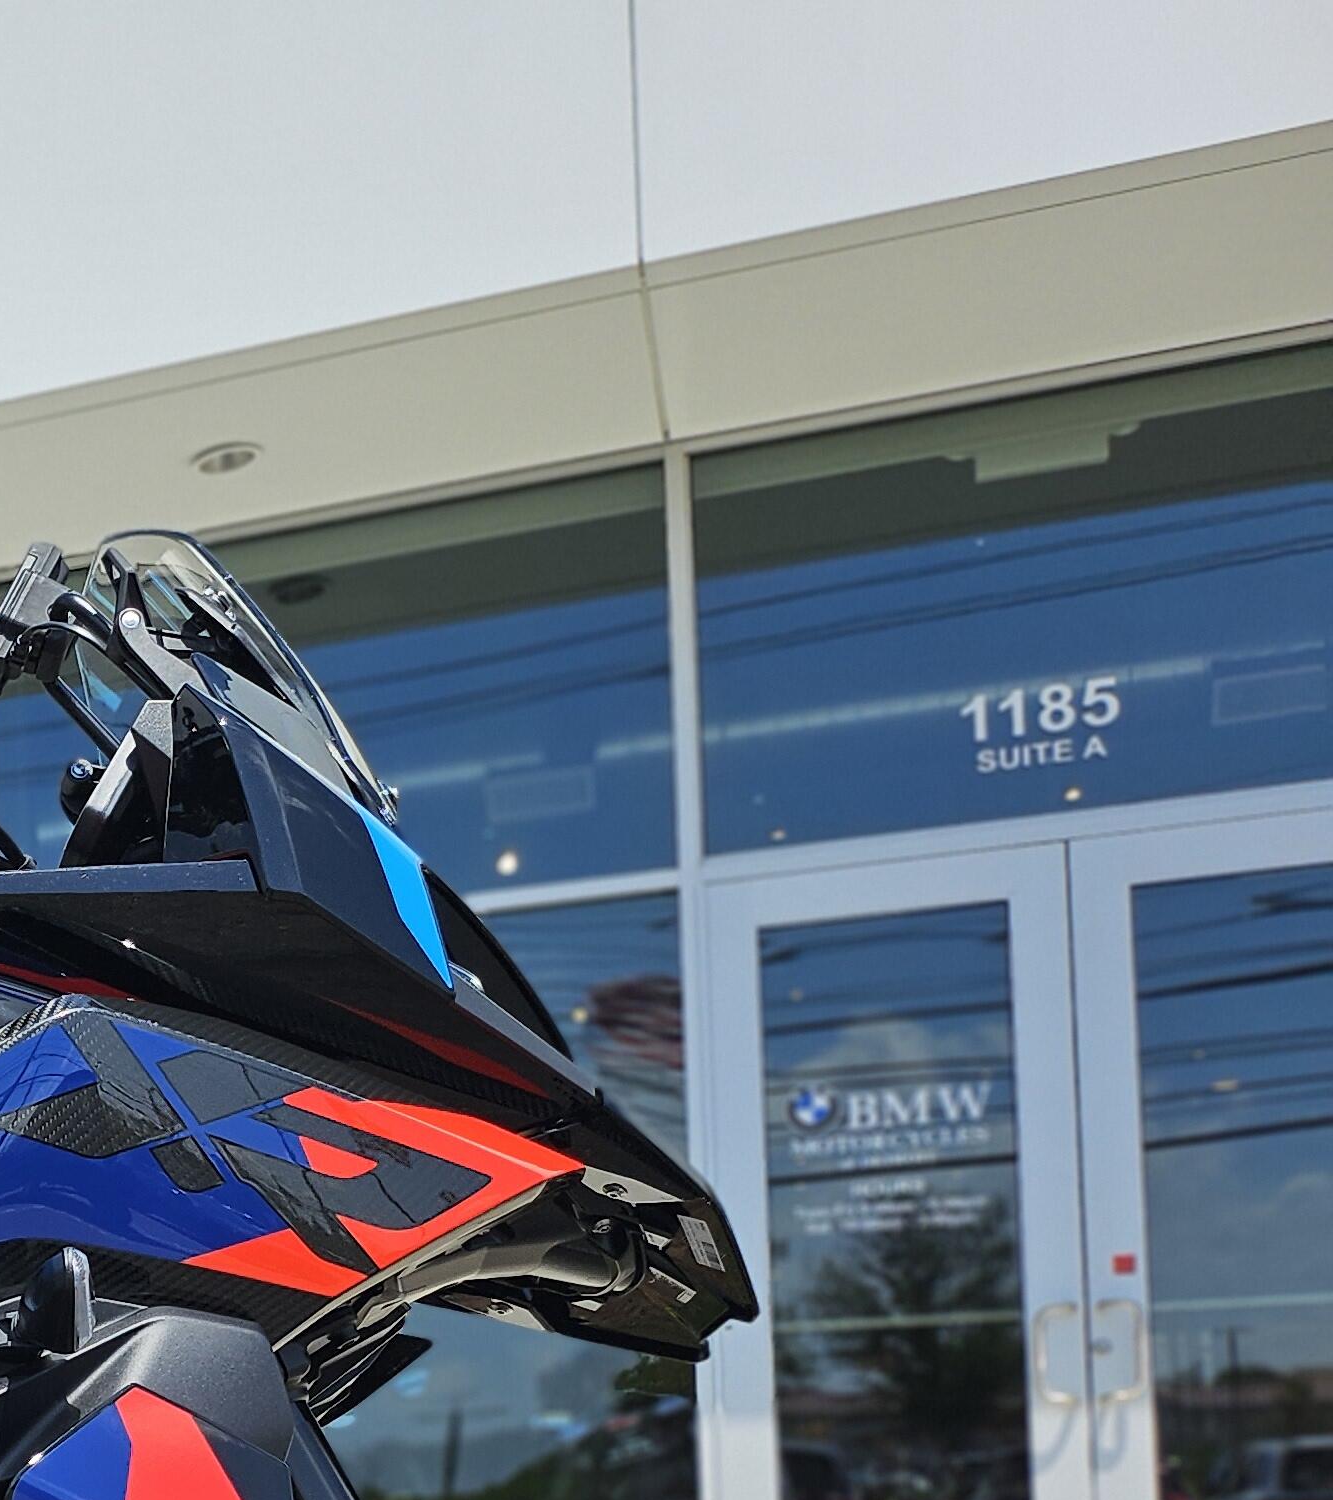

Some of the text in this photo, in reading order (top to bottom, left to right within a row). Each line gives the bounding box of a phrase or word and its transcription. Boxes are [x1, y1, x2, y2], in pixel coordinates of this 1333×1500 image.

[959, 676, 1120, 742] 1185
[975, 735, 1108, 774] SUITE A
[846, 1080, 991, 1130] BMW
